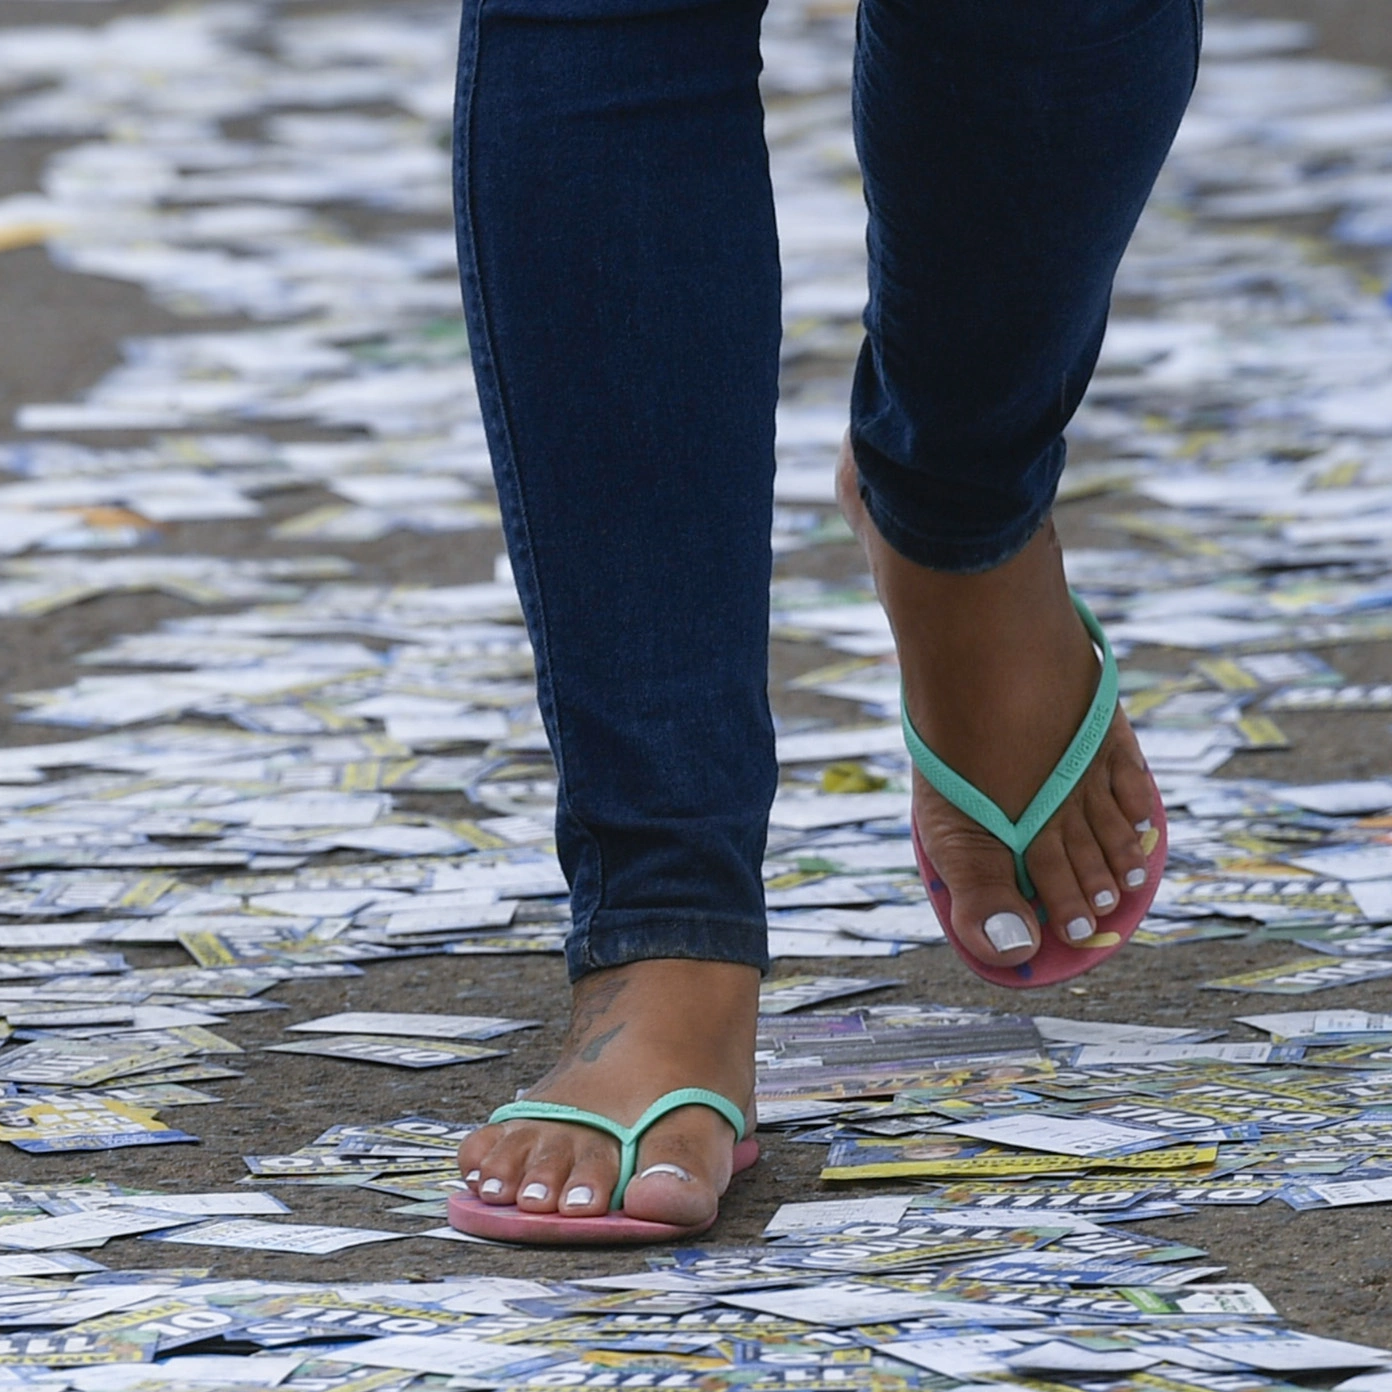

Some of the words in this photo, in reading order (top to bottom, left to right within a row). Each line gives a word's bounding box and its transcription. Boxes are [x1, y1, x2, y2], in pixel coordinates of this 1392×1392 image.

[1055, 704, 1110, 781] havaianas
[1088, 1104, 1217, 1129] 1110
[975, 1192, 1135, 1206] 1110
[843, 1226, 1003, 1240] 1110
[988, 1293, 1141, 1312] 1110
[281, 1306, 439, 1333] 1110
[527, 1372, 694, 1387] 1110
